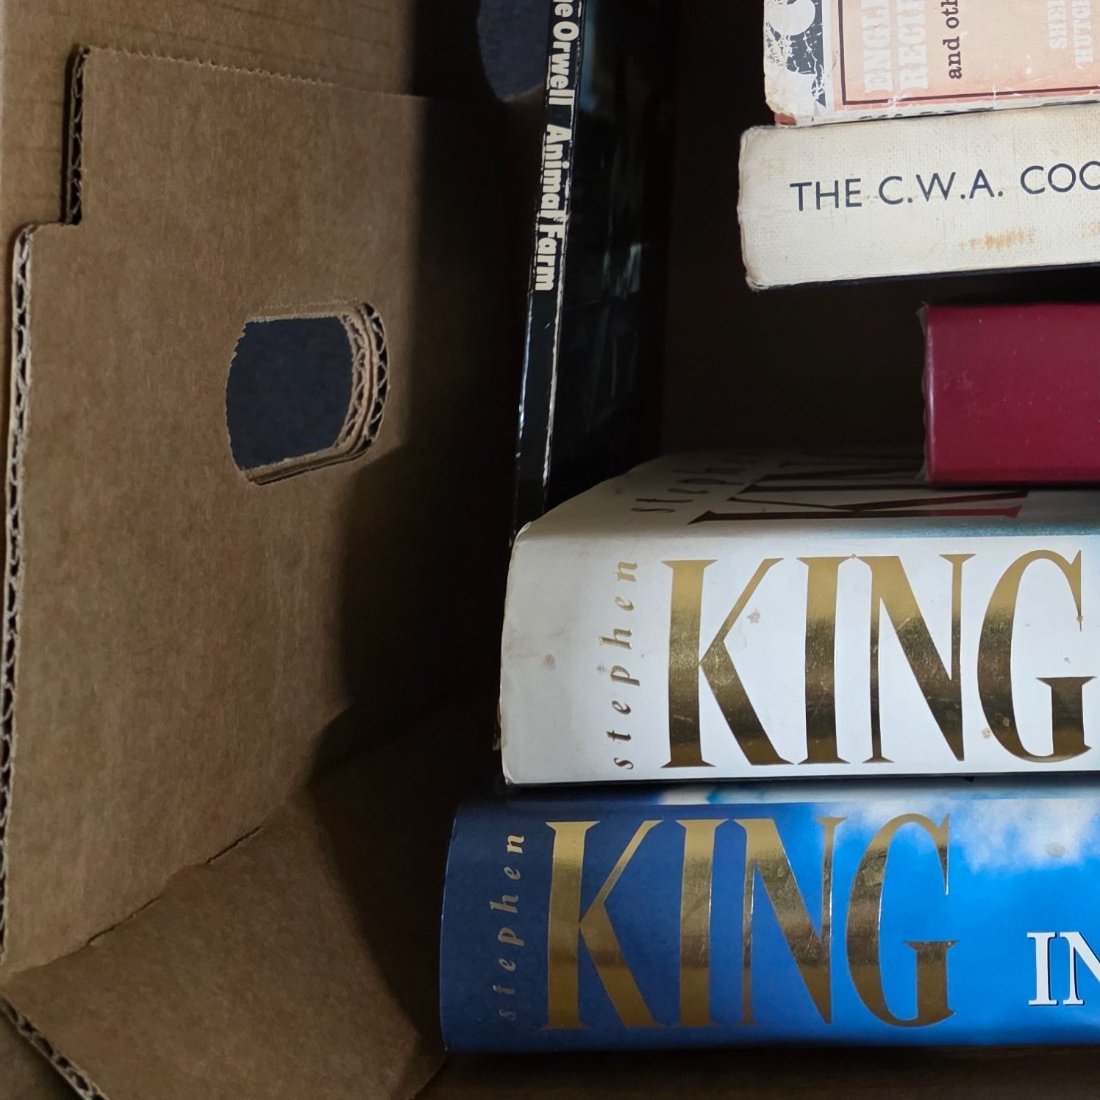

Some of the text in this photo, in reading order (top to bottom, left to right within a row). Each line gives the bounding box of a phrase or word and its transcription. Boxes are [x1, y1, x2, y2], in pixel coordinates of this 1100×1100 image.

[548, 19, 580, 107] Orwell
[942, 36, 963, 81] and
[540, 123, 573, 223] Animal
[789, 177, 863, 212] THE
[876, 167, 1006, 207] C.W.A.
[535, 222, 565, 293] Farm
[599, 557, 642, 771] stephen
[660, 548, 1098, 770] KING
[488, 833, 527, 1023] stephen
[540, 812, 960, 1032] KING
